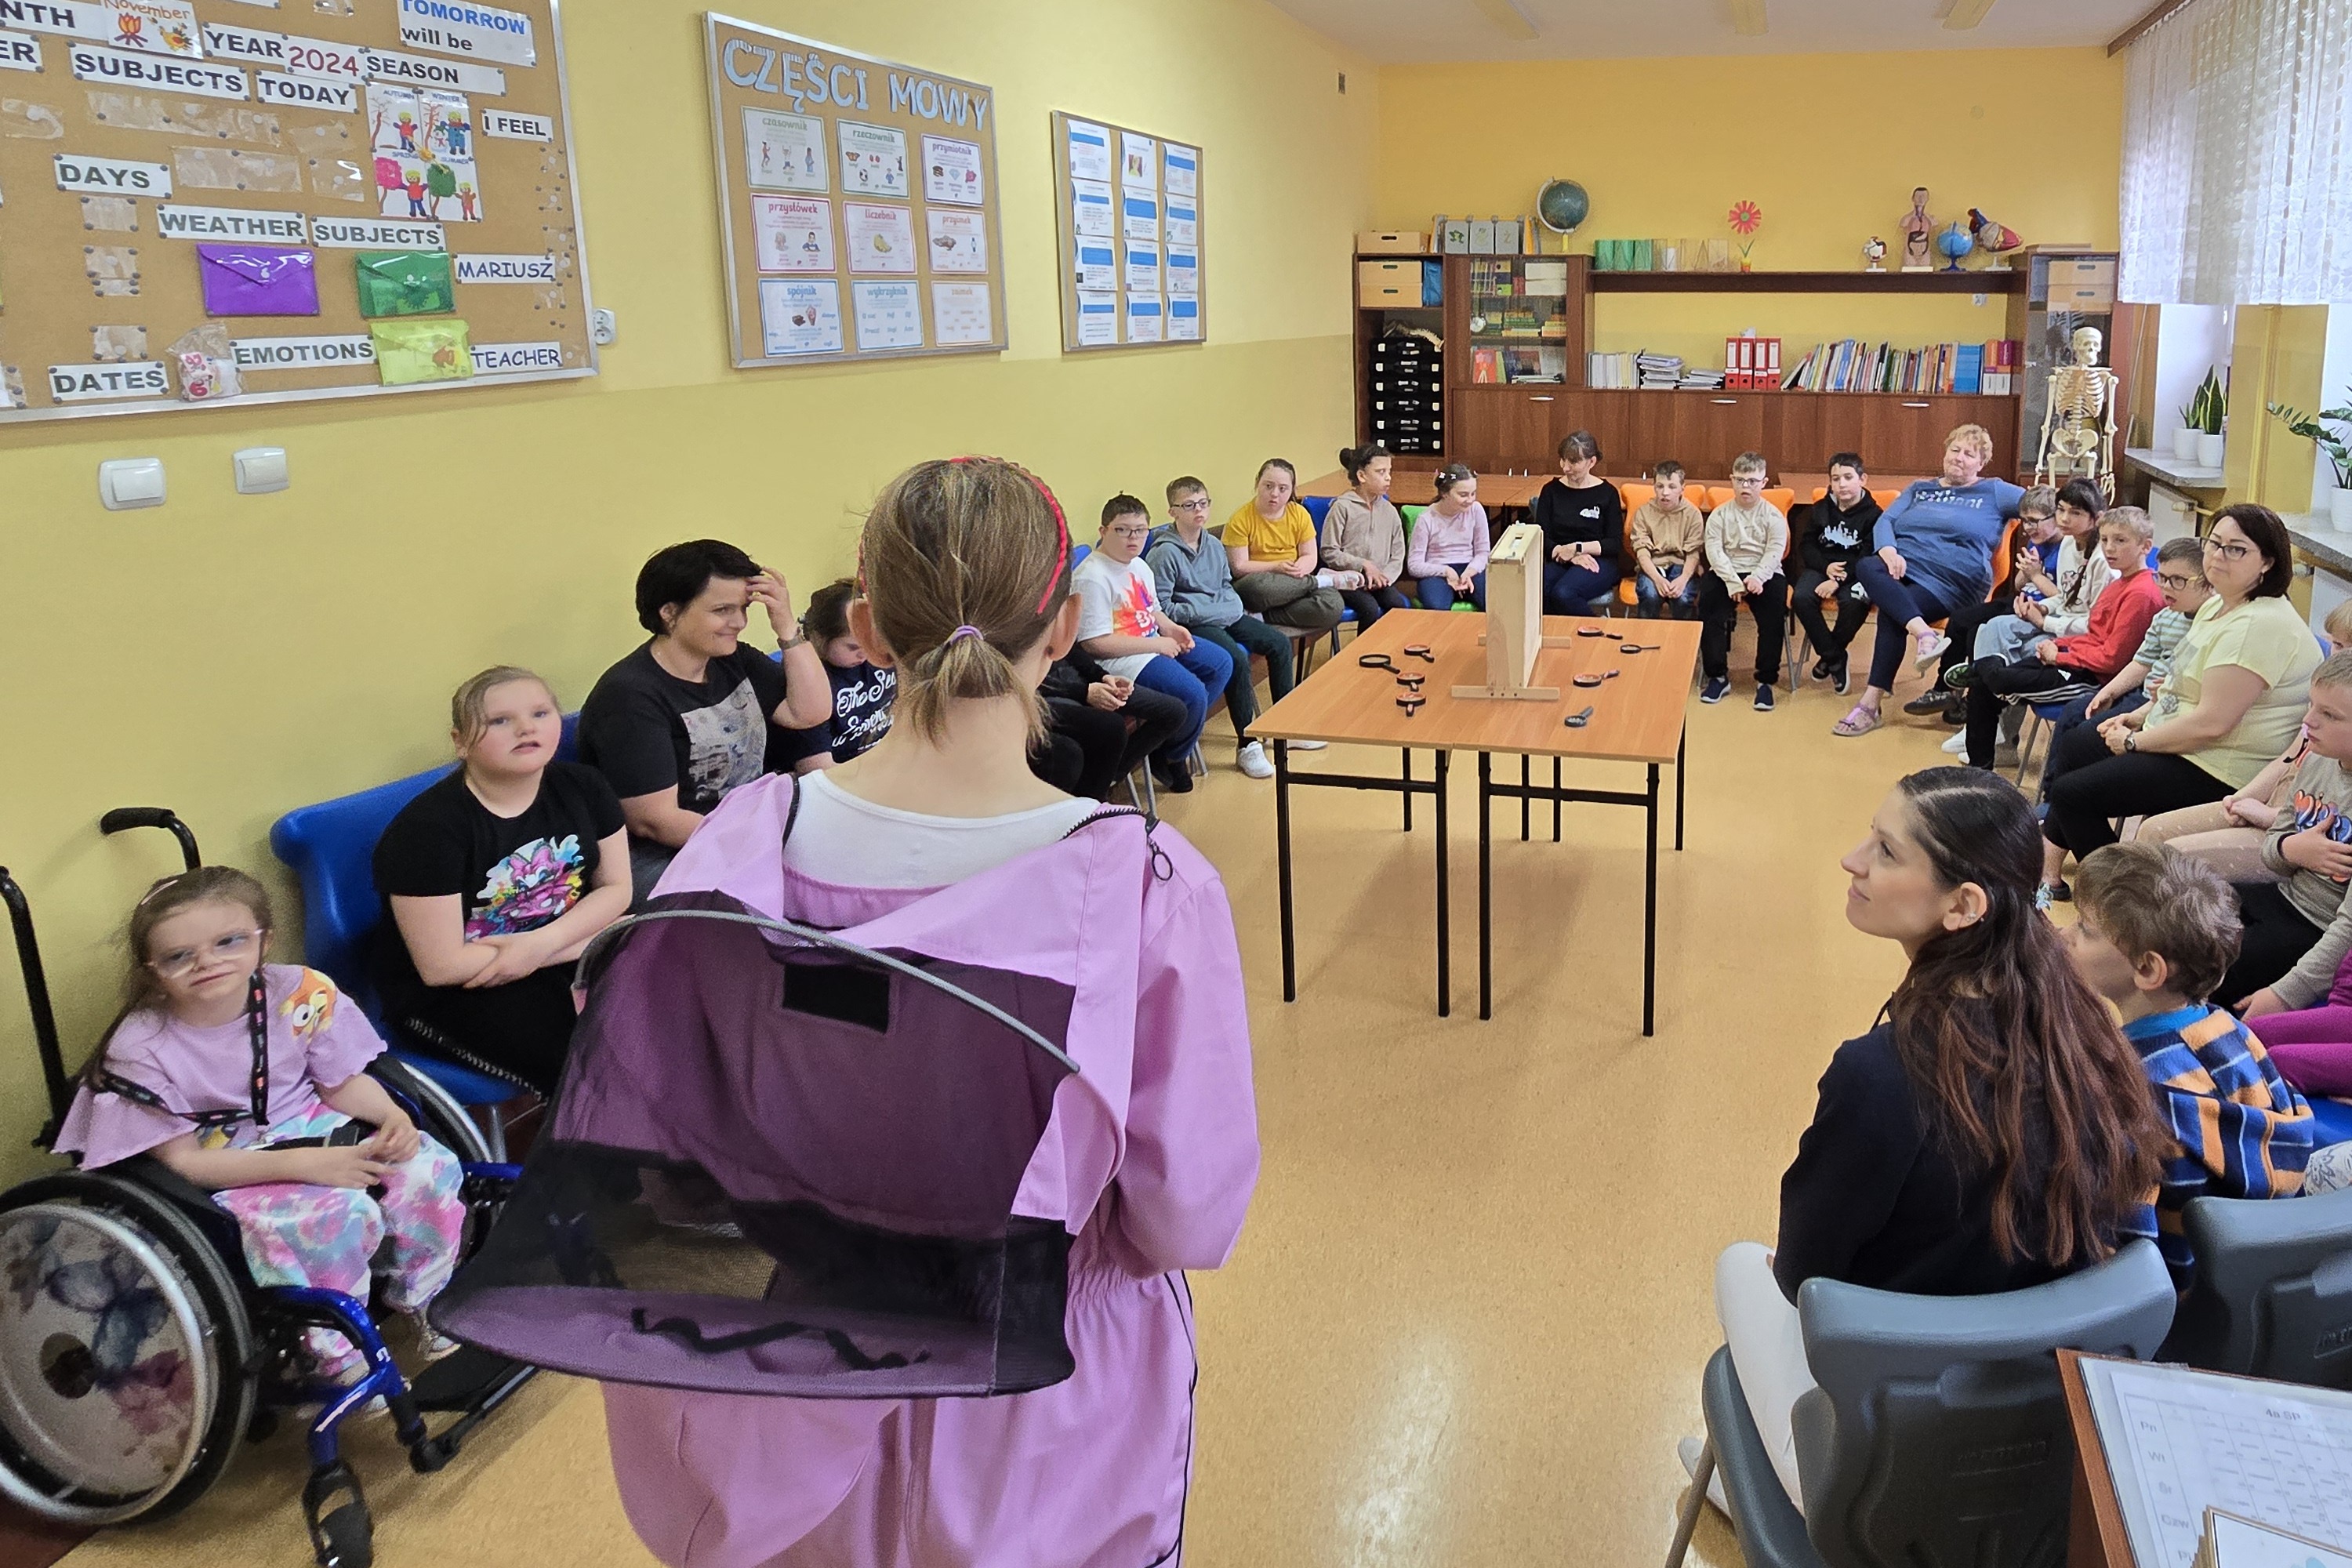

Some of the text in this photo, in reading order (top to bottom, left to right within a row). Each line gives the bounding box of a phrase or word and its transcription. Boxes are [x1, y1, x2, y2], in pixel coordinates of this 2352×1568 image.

[0, 0, 76, 28] NTH
[103, 0, 191, 20] November
[403, 0, 525, 35] TOMORROW
[401, 27, 473, 51] will be
[204, 30, 359, 77] YEAR 2024
[75, 53, 243, 93] SUBJECTS
[366, 56, 459, 83] SEASON
[259, 78, 350, 105] TODAY
[383, 89, 415, 100] AUTUMN
[724, 39, 988, 131] CZĘŚCI MOWY
[484, 115, 546, 136] I FEEL
[762, 117, 808, 131] czasownik
[852, 129, 895, 143] rzeczownik
[59, 164, 150, 188] DAYS
[768, 201, 818, 214] przysłówek
[865, 209, 896, 220] liczebnik
[159, 213, 303, 237] WEATHER
[314, 224, 441, 245] SUBJECTS
[458, 261, 554, 278] MARIUSZ
[787, 285, 817, 298] spójnik
[235, 343, 374, 365] EMOTIONS
[471, 349, 561, 368] TEACHER
[53, 370, 165, 392] DATES
[837, 681, 868, 717] The
